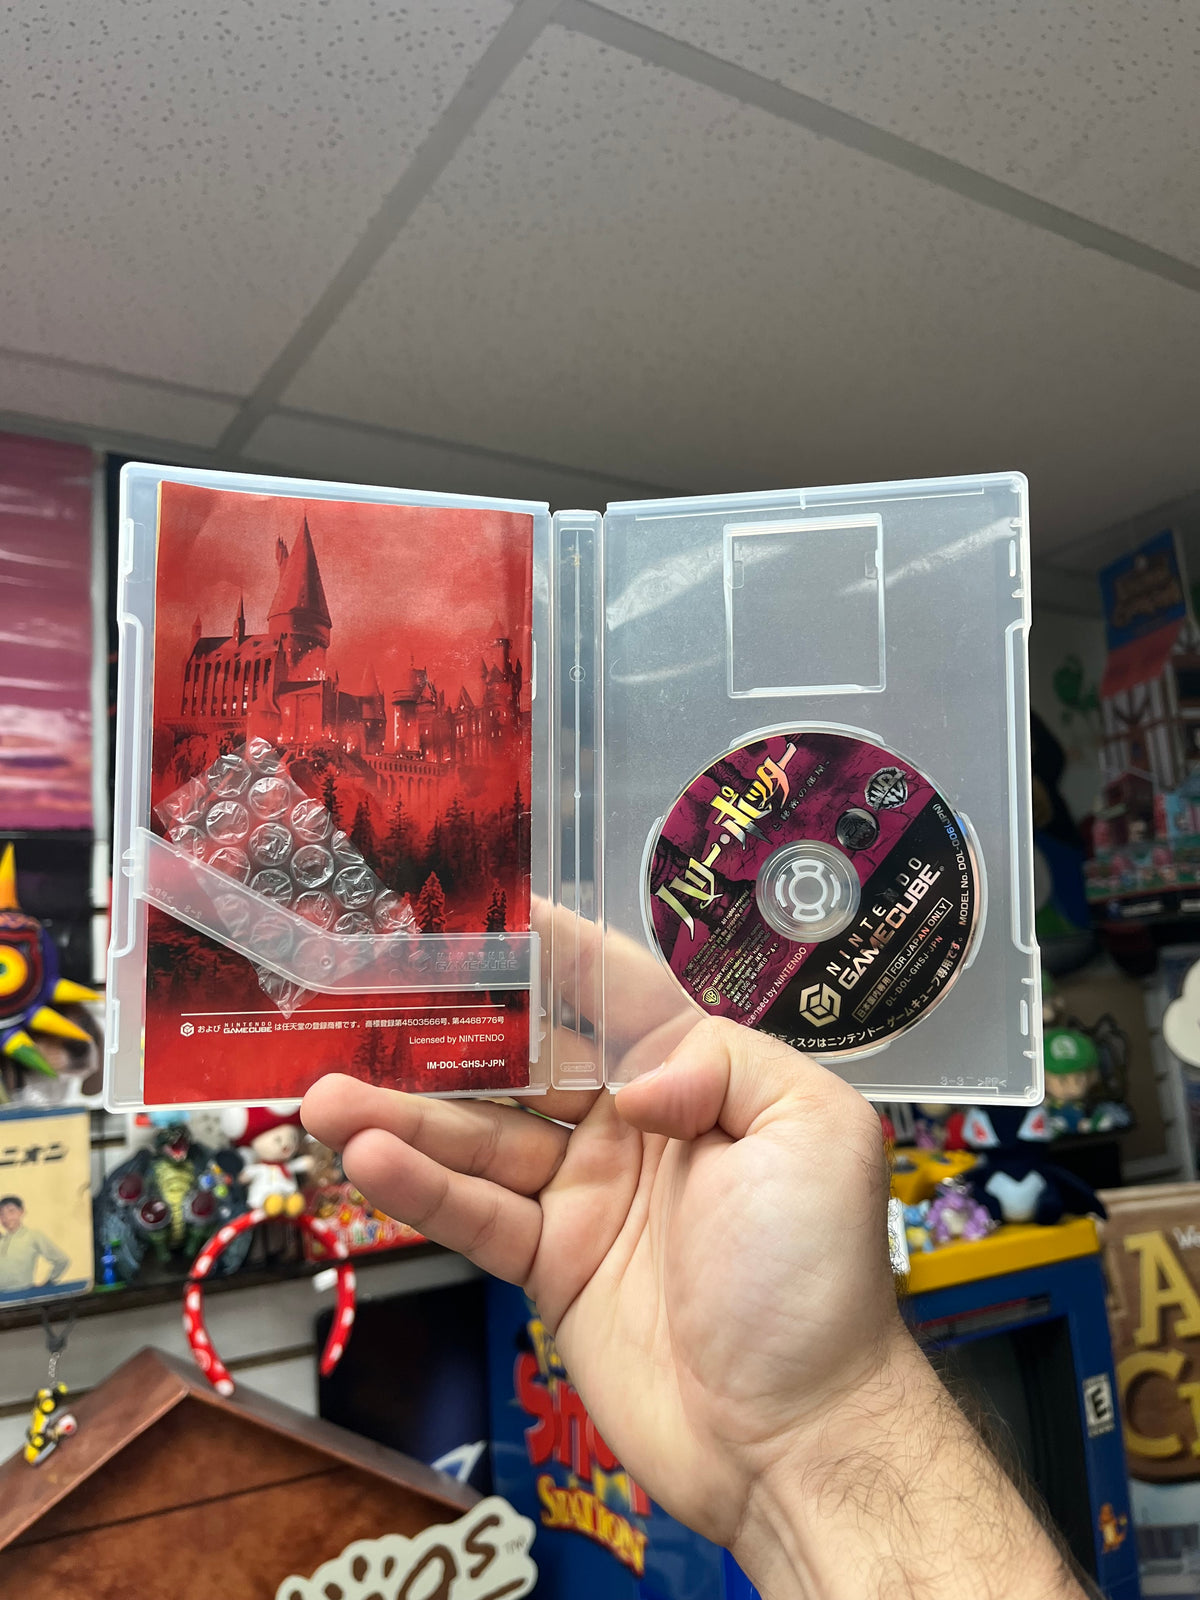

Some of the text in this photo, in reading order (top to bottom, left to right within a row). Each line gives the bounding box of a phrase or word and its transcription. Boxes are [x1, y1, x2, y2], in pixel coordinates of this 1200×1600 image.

[960, 872, 969, 888] No.
[825, 855, 923, 976] NINTENDO
[958, 889, 969, 926] MODEL
[889, 902, 948, 974] FOR JAPAN ONLY
[436, 959, 518, 971] GAMECUBE
[772, 945, 808, 987] NINTENDO
[884, 934, 943, 1007] DL-DOL-GHSJ-JPN
[766, 985, 779, 999] by
[197, 1024, 221, 1033] および
[224, 1026, 273, 1034] GAMECUBE
[409, 1034, 505, 1045] Licensed by NINTENDO
[427, 1059, 505, 1070] IM-DOL-GHSJ-JPN
[1091, 1387, 1107, 1419] E
